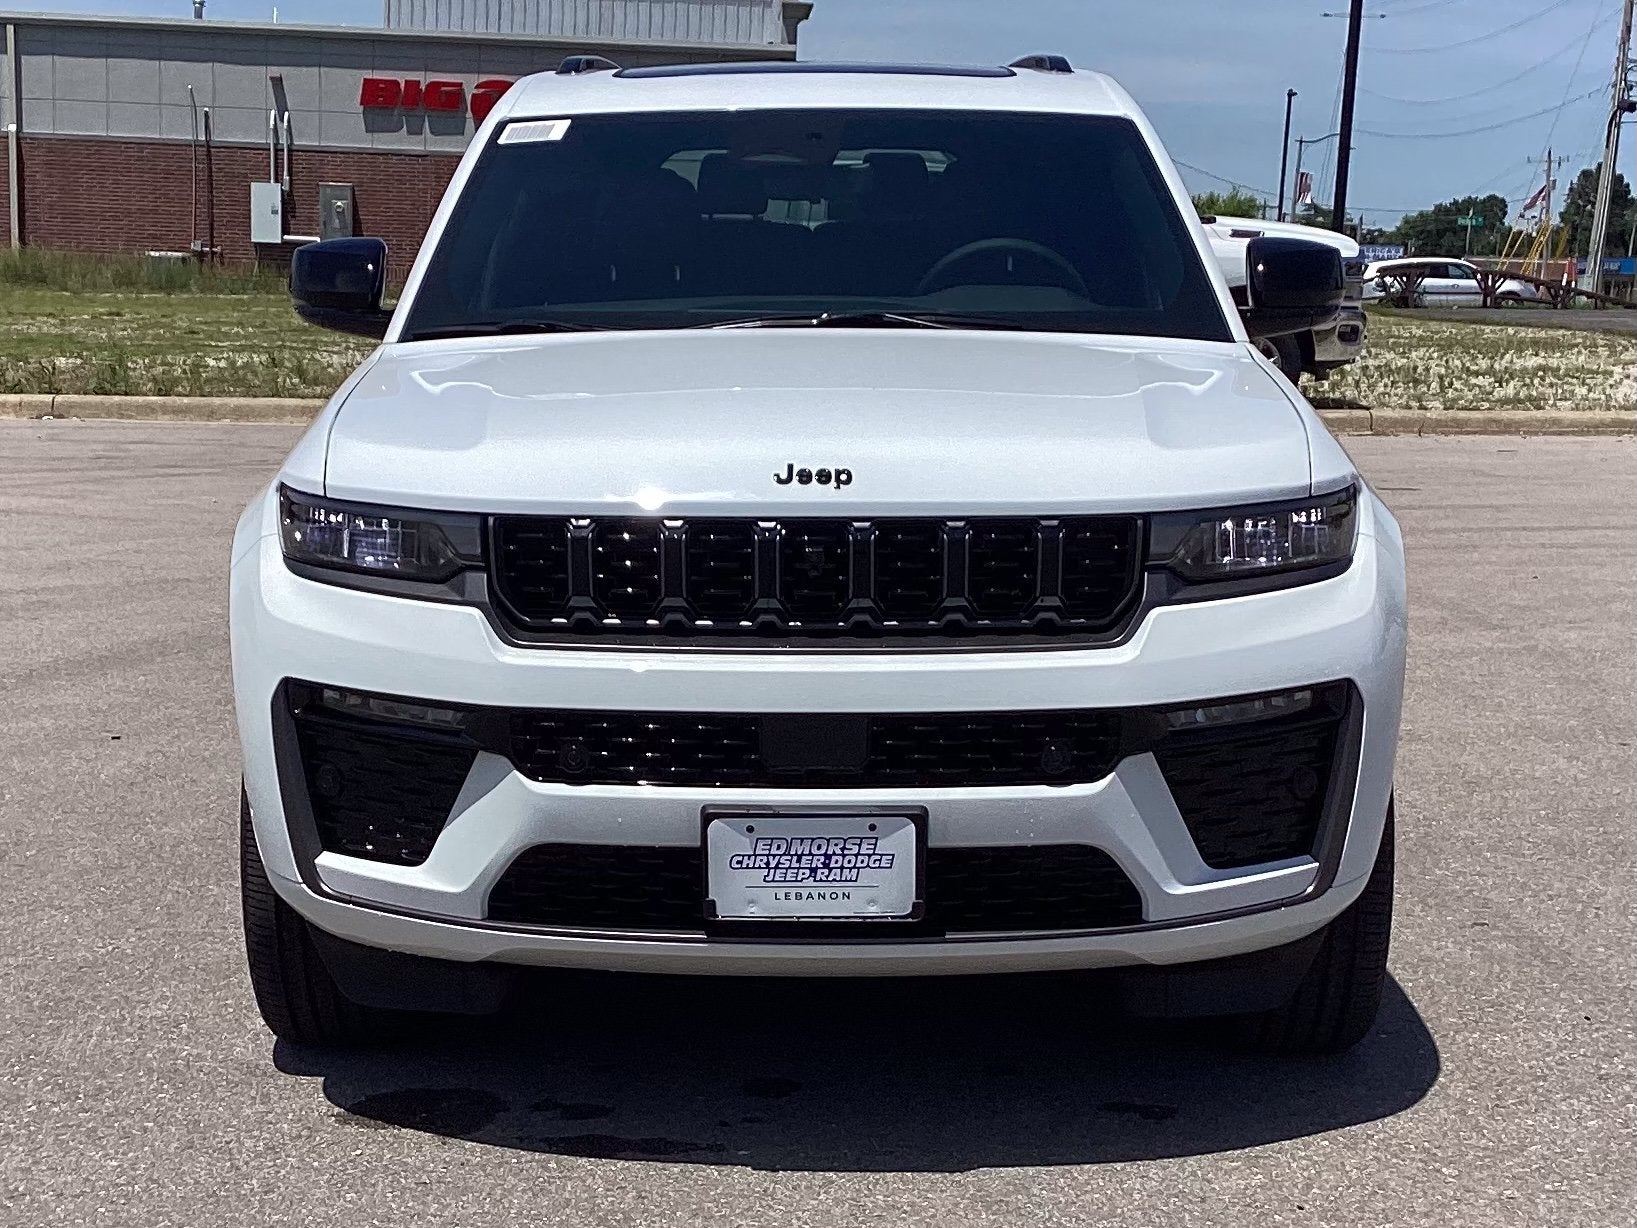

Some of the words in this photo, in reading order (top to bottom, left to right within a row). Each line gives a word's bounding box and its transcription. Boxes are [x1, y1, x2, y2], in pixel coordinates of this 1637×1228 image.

[360, 78, 465, 111] BIG
[773, 463, 853, 489] Jeep
[755, 838, 788, 855] ED
[789, 838, 878, 855] MORSE
[730, 855, 825, 868] CHRYSLER
[829, 855, 895, 868] DODGE
[774, 891, 851, 901] LEBANON
